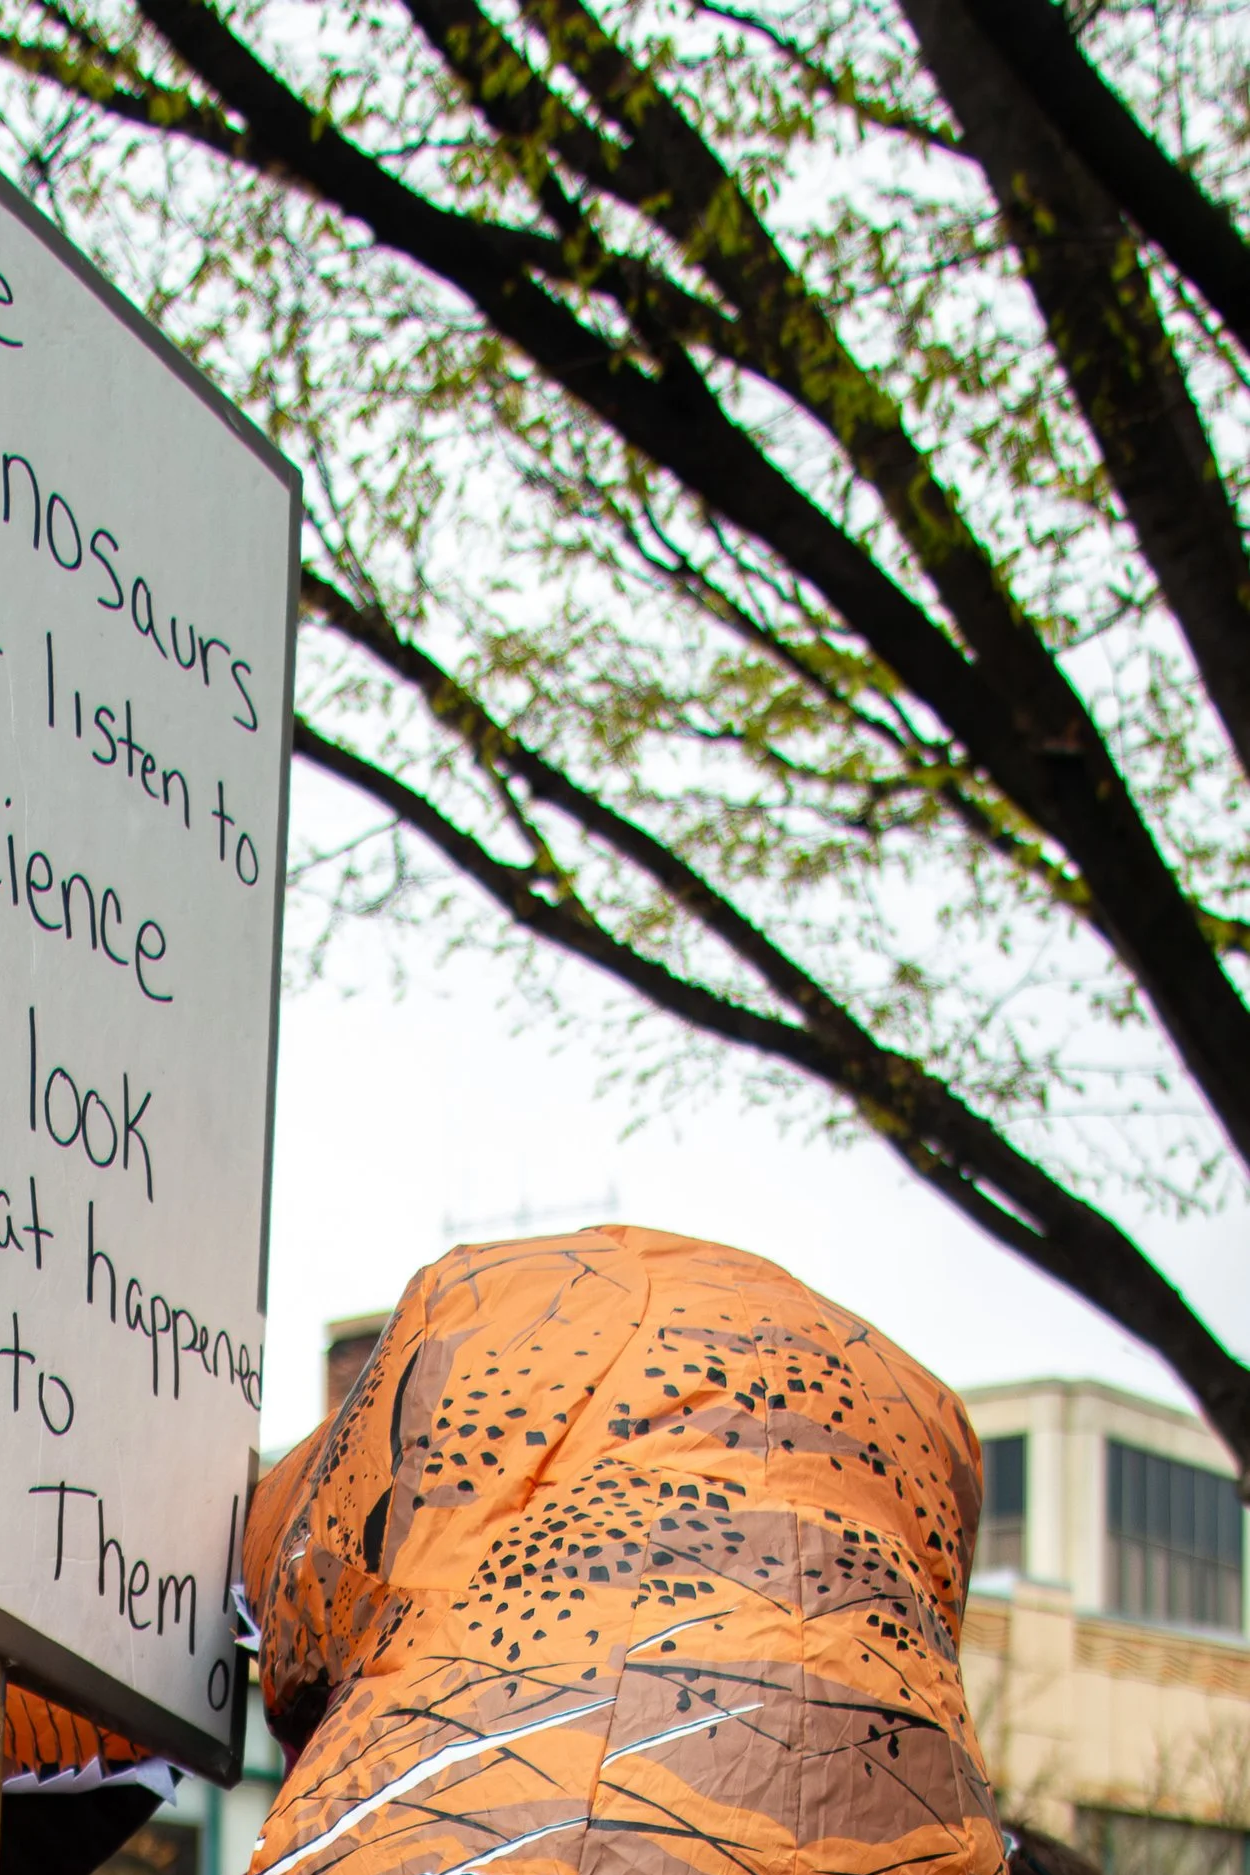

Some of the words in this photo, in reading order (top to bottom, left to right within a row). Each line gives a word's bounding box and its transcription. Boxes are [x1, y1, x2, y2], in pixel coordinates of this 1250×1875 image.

[46, 632, 191, 829] listen
[211, 781, 259, 887] to
[28, 1006, 154, 1202] look
[87, 1201, 264, 1413] happened
